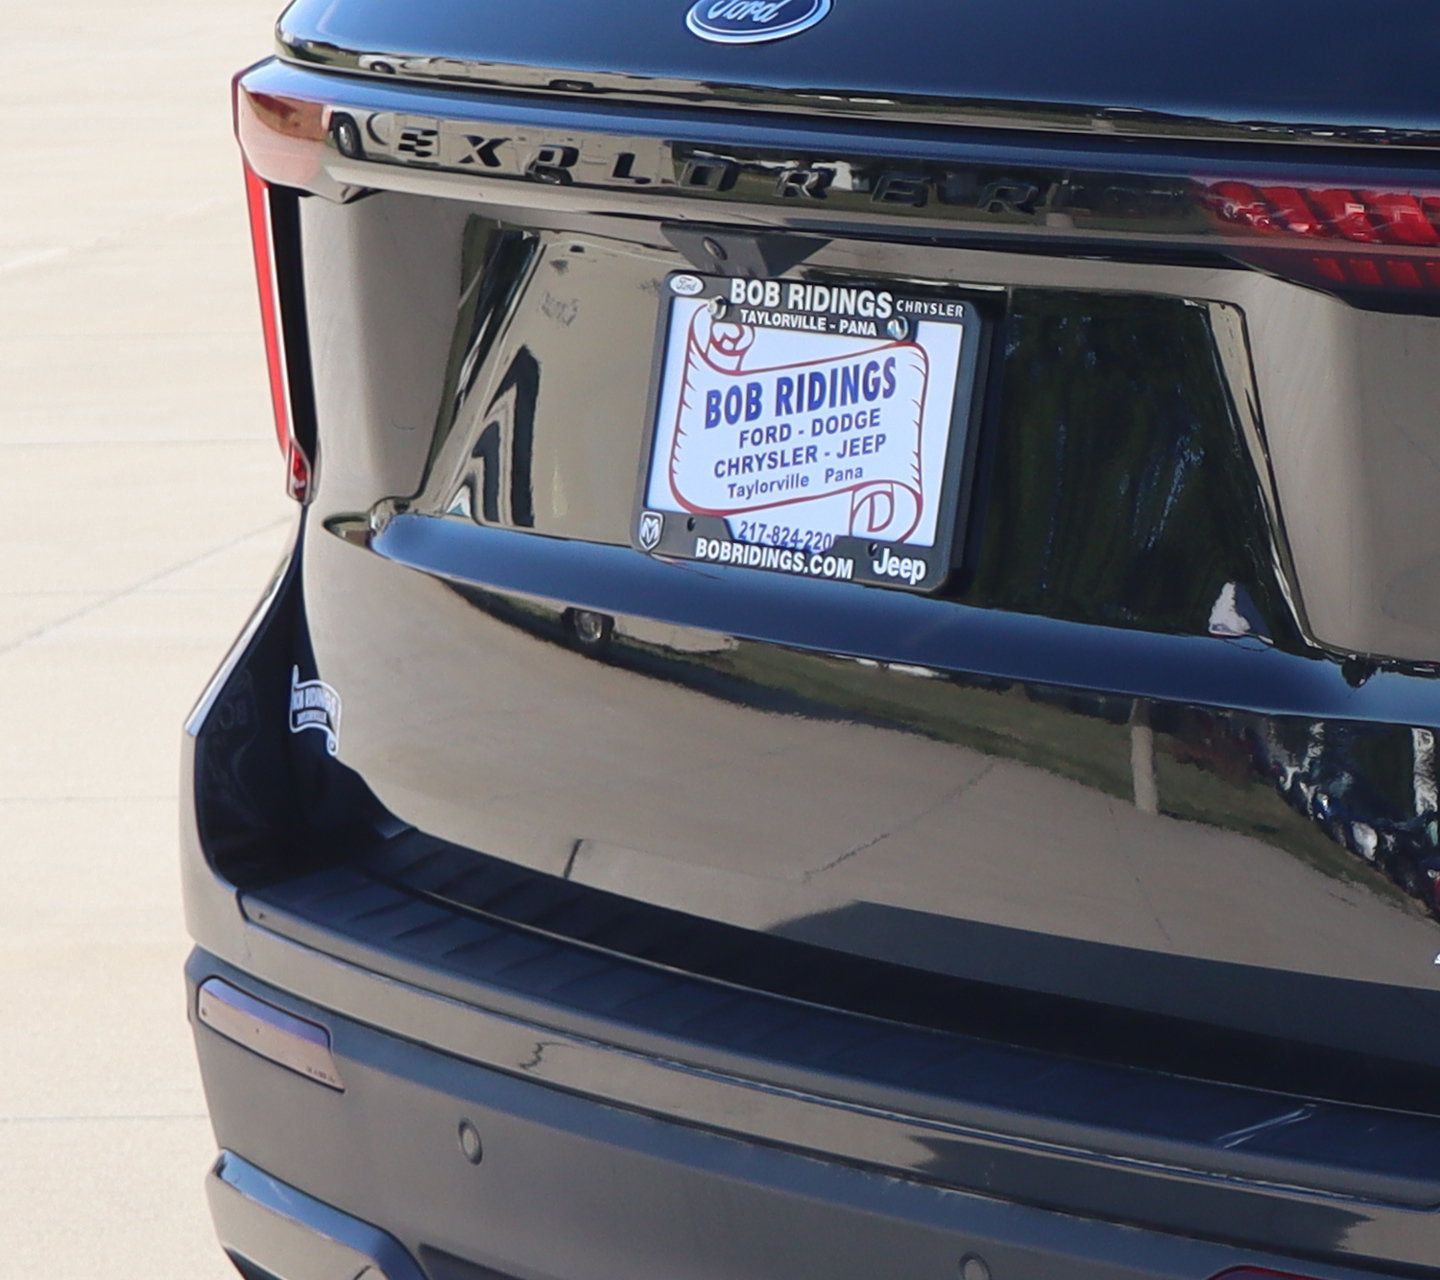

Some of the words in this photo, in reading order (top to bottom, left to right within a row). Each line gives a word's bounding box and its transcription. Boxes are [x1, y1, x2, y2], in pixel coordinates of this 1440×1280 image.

[395, 124, 1041, 216] EXPLORER
[730, 277, 782, 308] BOB
[788, 282, 894, 320] RIDINGS
[896, 299, 964, 318] CHRYSLER
[740, 308, 826, 332] TAYLORVILLE
[839, 321, 877, 338] PANA
[704, 381, 764, 430] BOB
[775, 356, 897, 418] RIDINGS
[738, 423, 793, 450] FORD
[811, 407, 882, 438] DODGE
[713, 445, 819, 479] CHRYSLER
[836, 433, 887, 460] JEEP
[727, 472, 810, 500] Taylorville
[824, 466, 864, 484] Pana
[738, 521, 836, 552] 217-824-220
[694, 537, 854, 580] BOBRIDINGS.COM
[872, 547, 926, 585] Jeep
